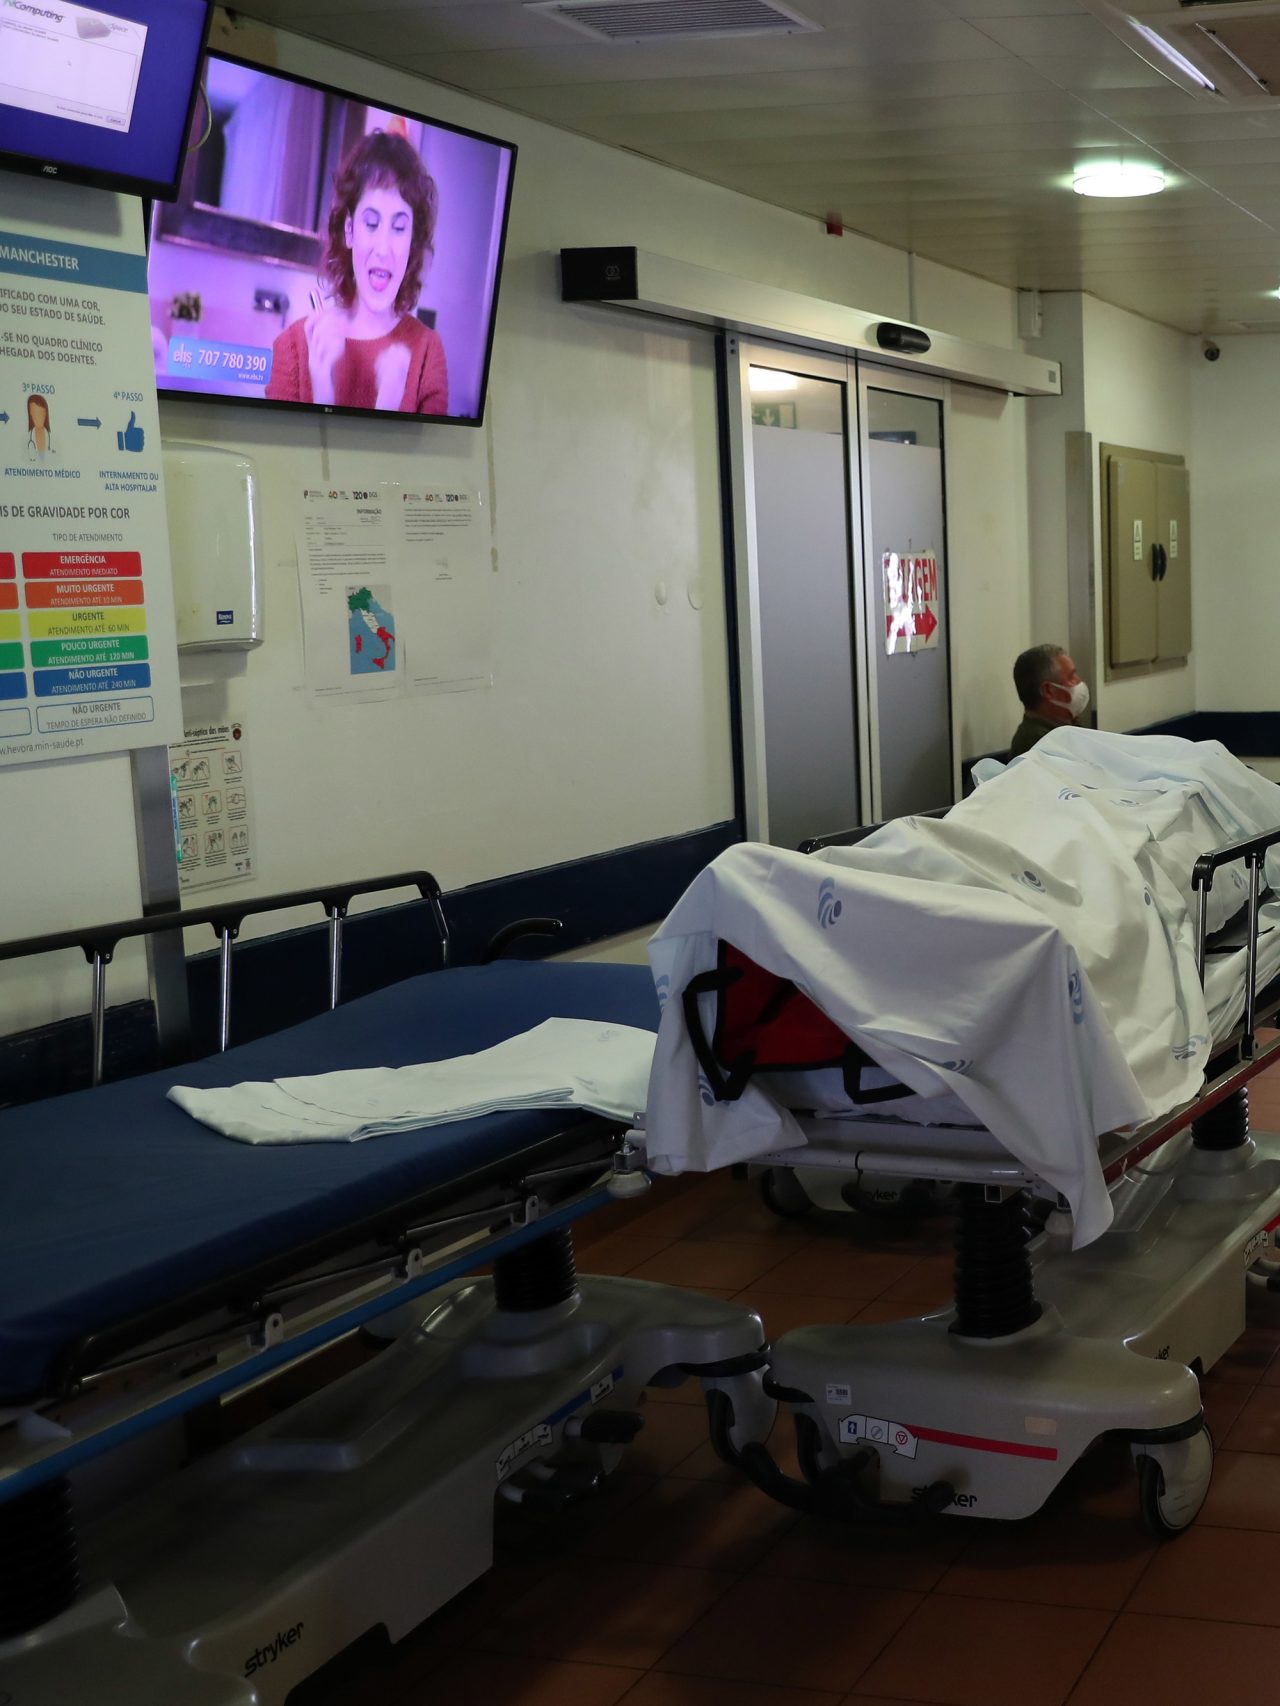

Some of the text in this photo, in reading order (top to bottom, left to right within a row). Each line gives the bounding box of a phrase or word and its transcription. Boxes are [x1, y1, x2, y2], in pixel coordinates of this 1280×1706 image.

[0, 245, 79, 271] MANCHESTER
[38, 294, 57, 305] COM
[60, 296, 79, 308] UMA
[82, 300, 100, 311] COR.
[11, 305, 27, 315] SEU
[30, 308, 62, 320] ESTADO
[64, 312, 75, 321] DE
[77, 313, 105, 325] SAÚDE.
[16, 334, 29, 344] NO
[32, 336, 68, 348] QUADRO
[71, 339, 102, 352] CLÍNICO
[38, 351, 55, 361] DOS
[58, 352, 96, 365] DOENTES.
[198, 350, 220, 366] 707
[222, 353, 243, 368] 780
[245, 356, 266, 371] 390
[32, 384, 55, 394] PASSO
[122, 393, 143, 401] PASSO
[5, 468, 80, 479] ATENDIMENTO MÉDICO
[100, 471, 148, 480] INTERNAMENTO
[12, 506, 25, 517] DE
[28, 506, 86, 518] GRAVIDADE
[89, 508, 108, 518] POR
[111, 508, 129, 519] COR
[53, 533, 68, 541] TIPO
[60, 554, 105, 564] EMERGÊNCIA
[57, 584, 115, 593] MUITO URGENTE
[51, 598, 89, 606] ATENDIMENTO
[72, 612, 104, 621] URGENTE
[48, 626, 93, 636] ATENDIMENTO
[95, 624, 105, 633] ATÉ
[117, 624, 129, 632] MIN
[61, 640, 120, 651] POUCO URGENTE
[48, 655, 94, 664] ATENDIMENTO
[96, 653, 105, 661] ATÉ
[69, 668, 118, 679] NÃO URGENTE
[52, 684, 96, 693] ATENDIMENTO
[98, 682, 108, 690] ATÉ
[72, 703, 121, 714] NÃO URGENTE
[80, 718, 103, 726] ESPERA
[104, 715, 117, 724] NÃO
[119, 713, 146, 722] DEFINIDO
[244, 1621, 304, 1678] stryker
